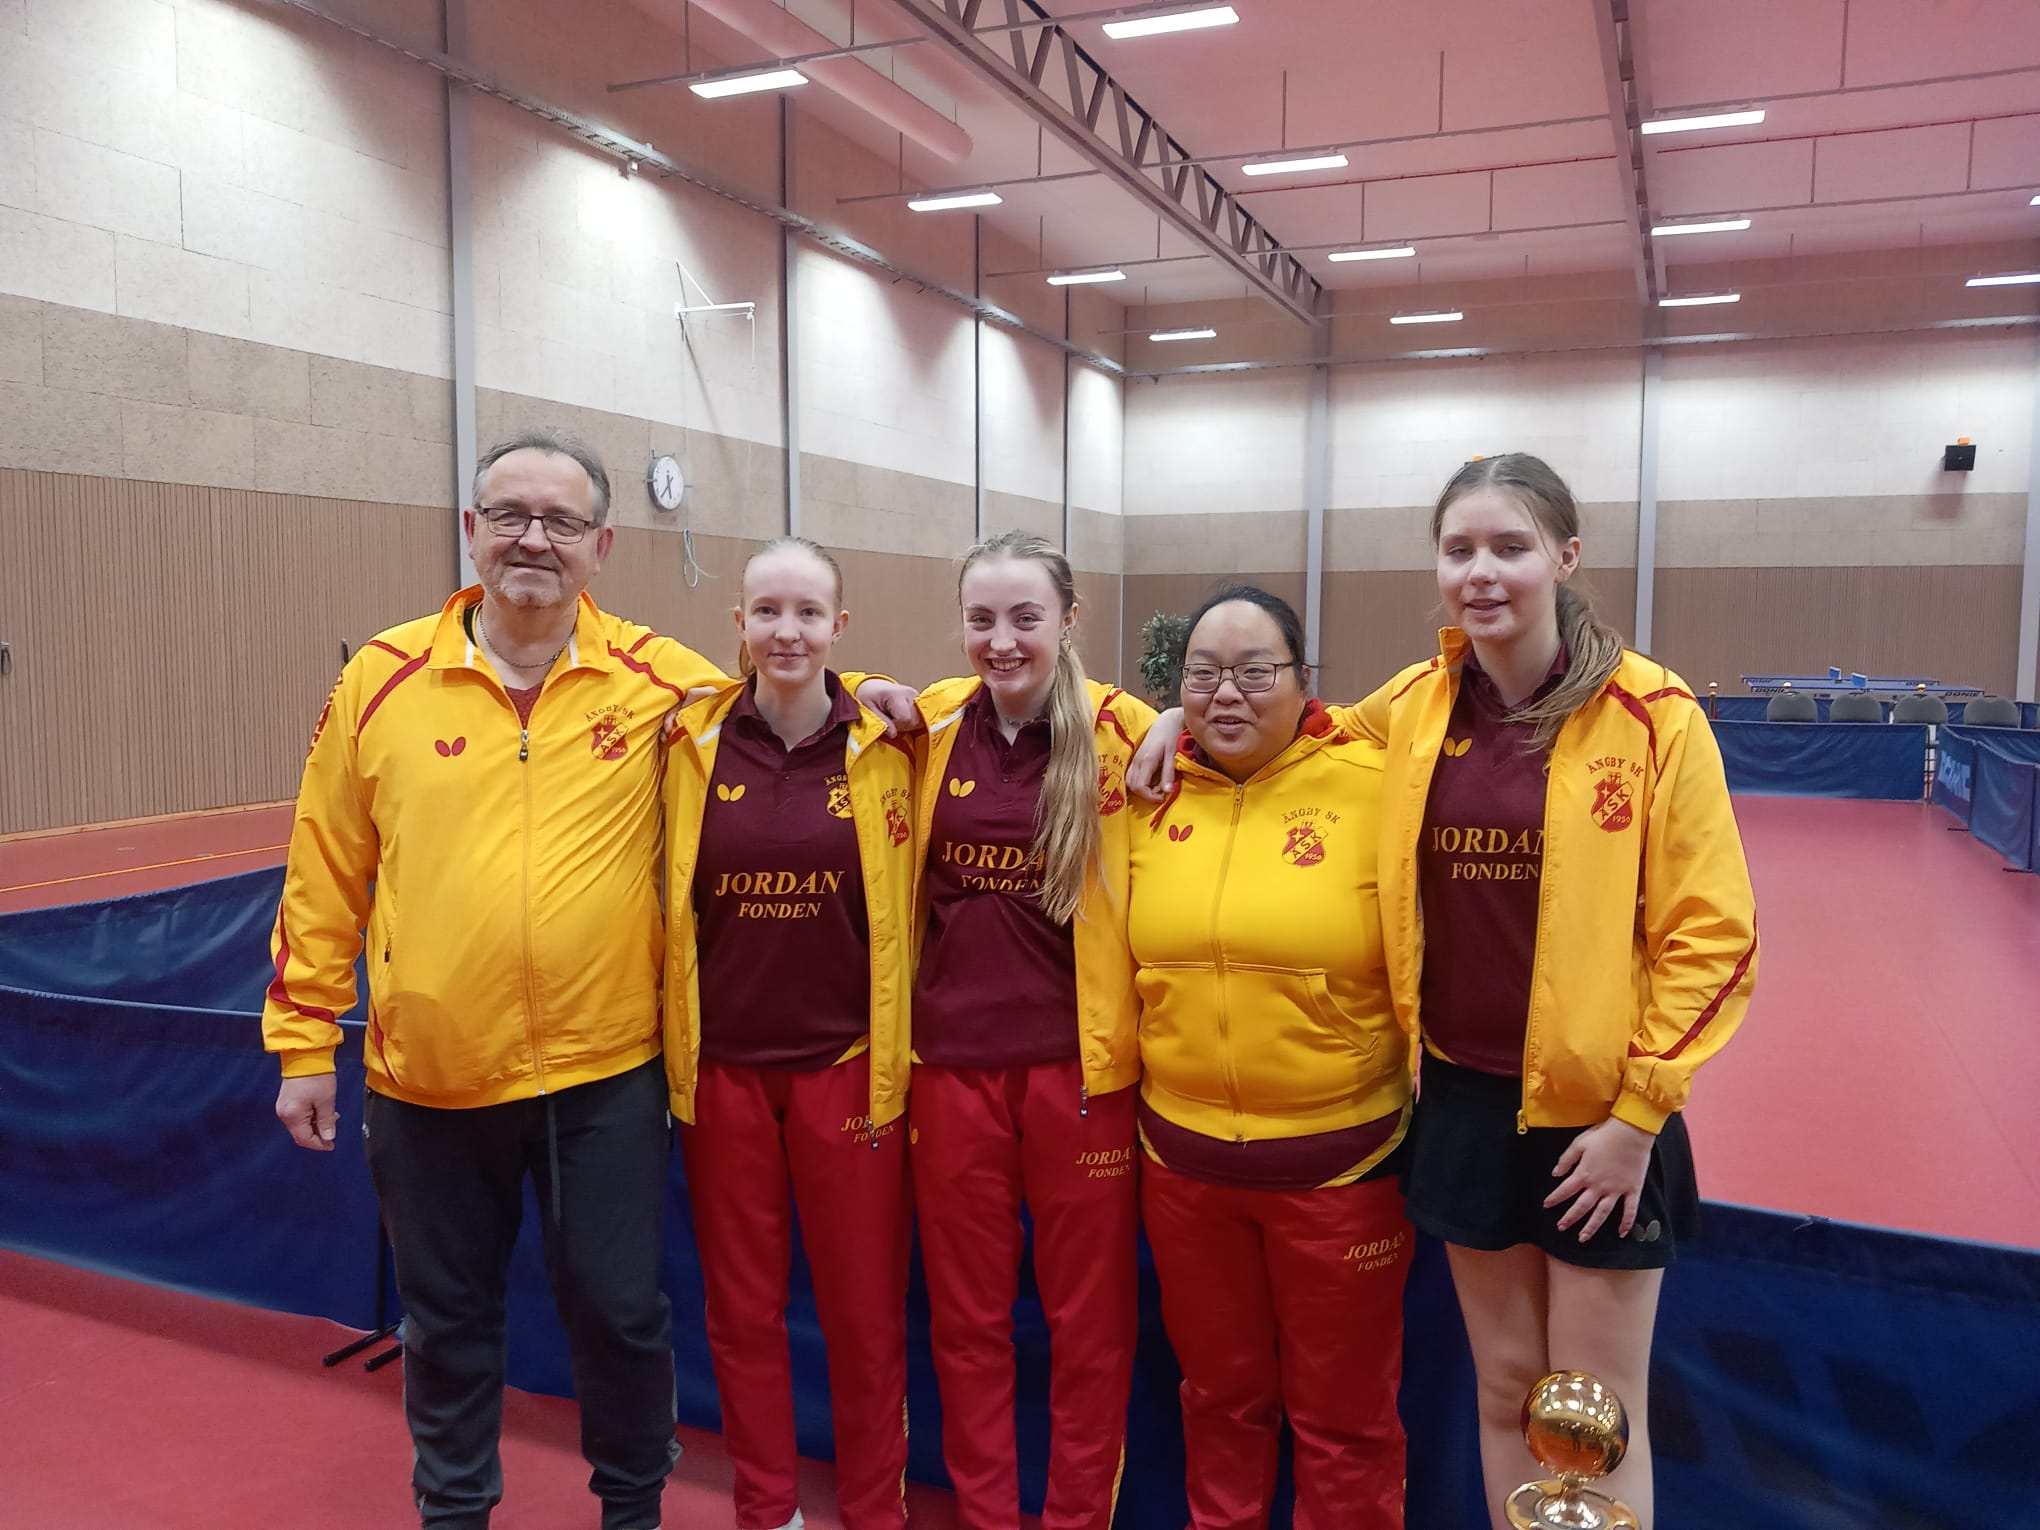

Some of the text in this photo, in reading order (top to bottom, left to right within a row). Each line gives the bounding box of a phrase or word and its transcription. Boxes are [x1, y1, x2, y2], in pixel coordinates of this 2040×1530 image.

[1586, 756, 1645, 778] ÄNGBY SK
[941, 841, 1046, 872] JORDA
[1451, 862, 1539, 881] FONDEN
[715, 870, 846, 897] JORDAN
[738, 902, 823, 919] FONDEN
